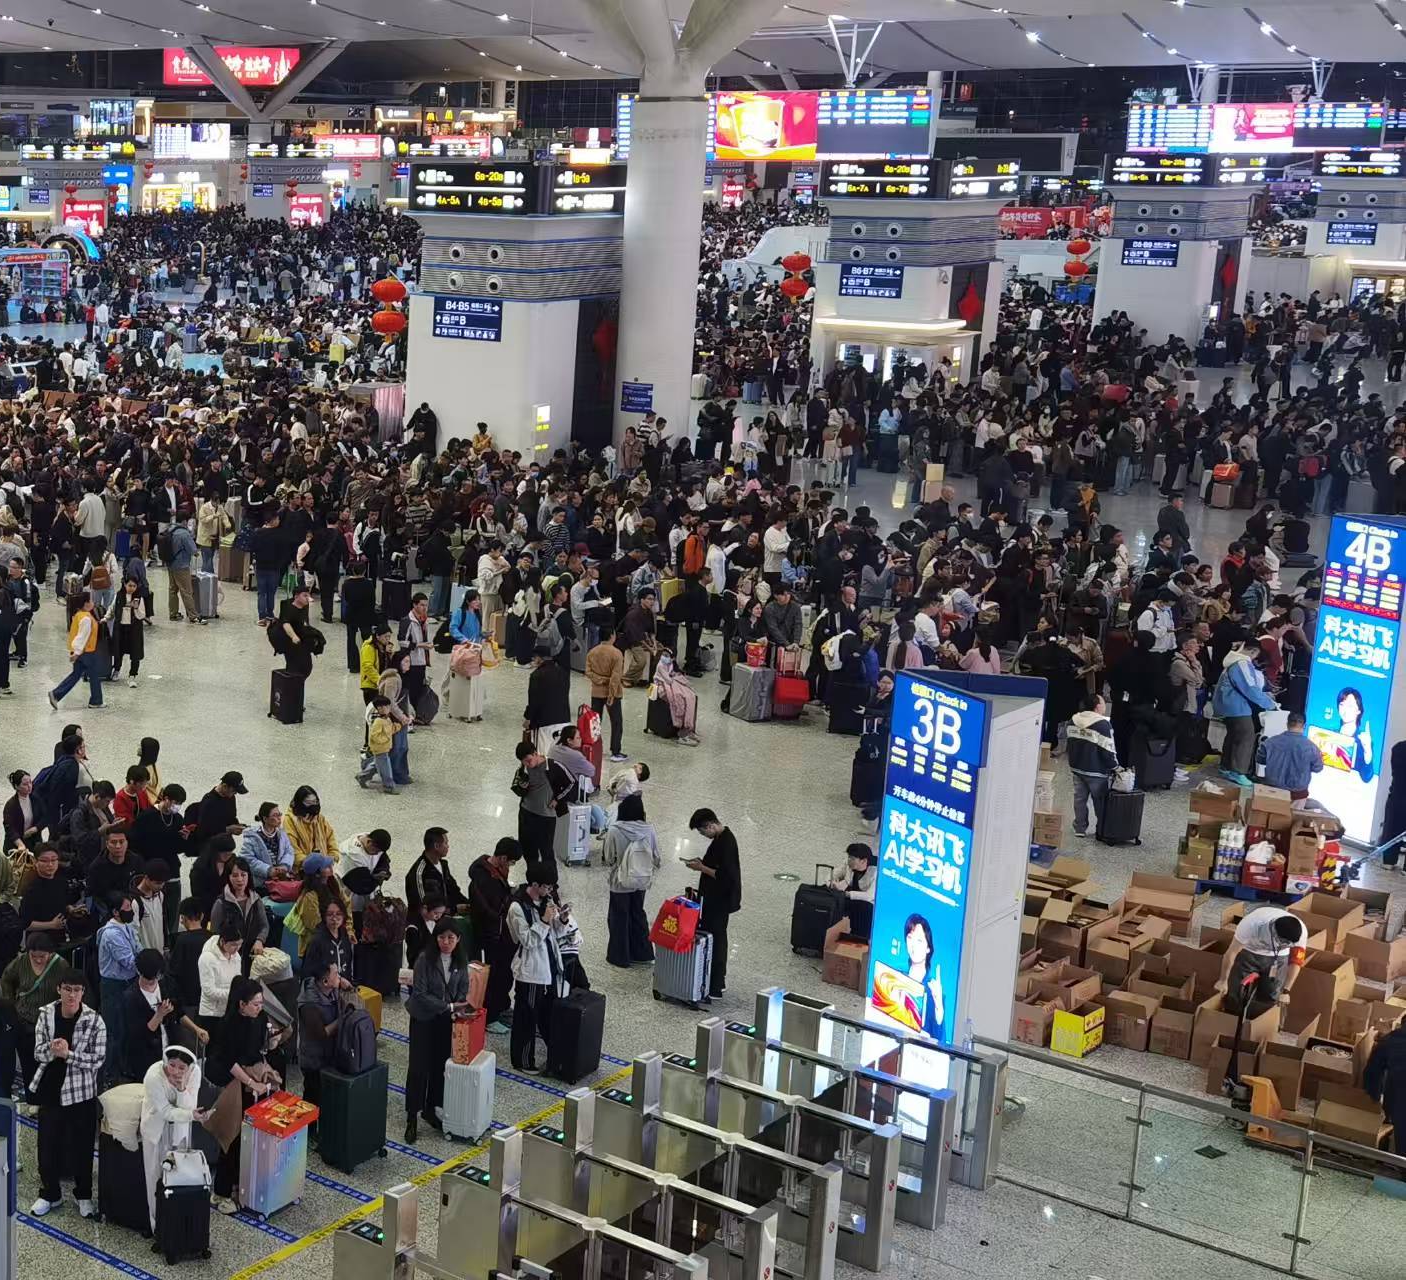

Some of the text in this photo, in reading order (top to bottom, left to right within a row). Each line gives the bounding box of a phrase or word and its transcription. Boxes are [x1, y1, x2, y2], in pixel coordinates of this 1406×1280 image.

[475, 171, 503, 181] 6B-20B
[437, 195, 503, 206] 4A-5A 4B-5B
[460, 315, 466, 325] B
[1344, 532, 1391, 571] 4B
[1323, 614, 1393, 649] 科大讯飞
[911, 698, 962, 755] 3B
[888, 808, 966, 866] 科大讯飞
[883, 839, 963, 895] AI学习机
